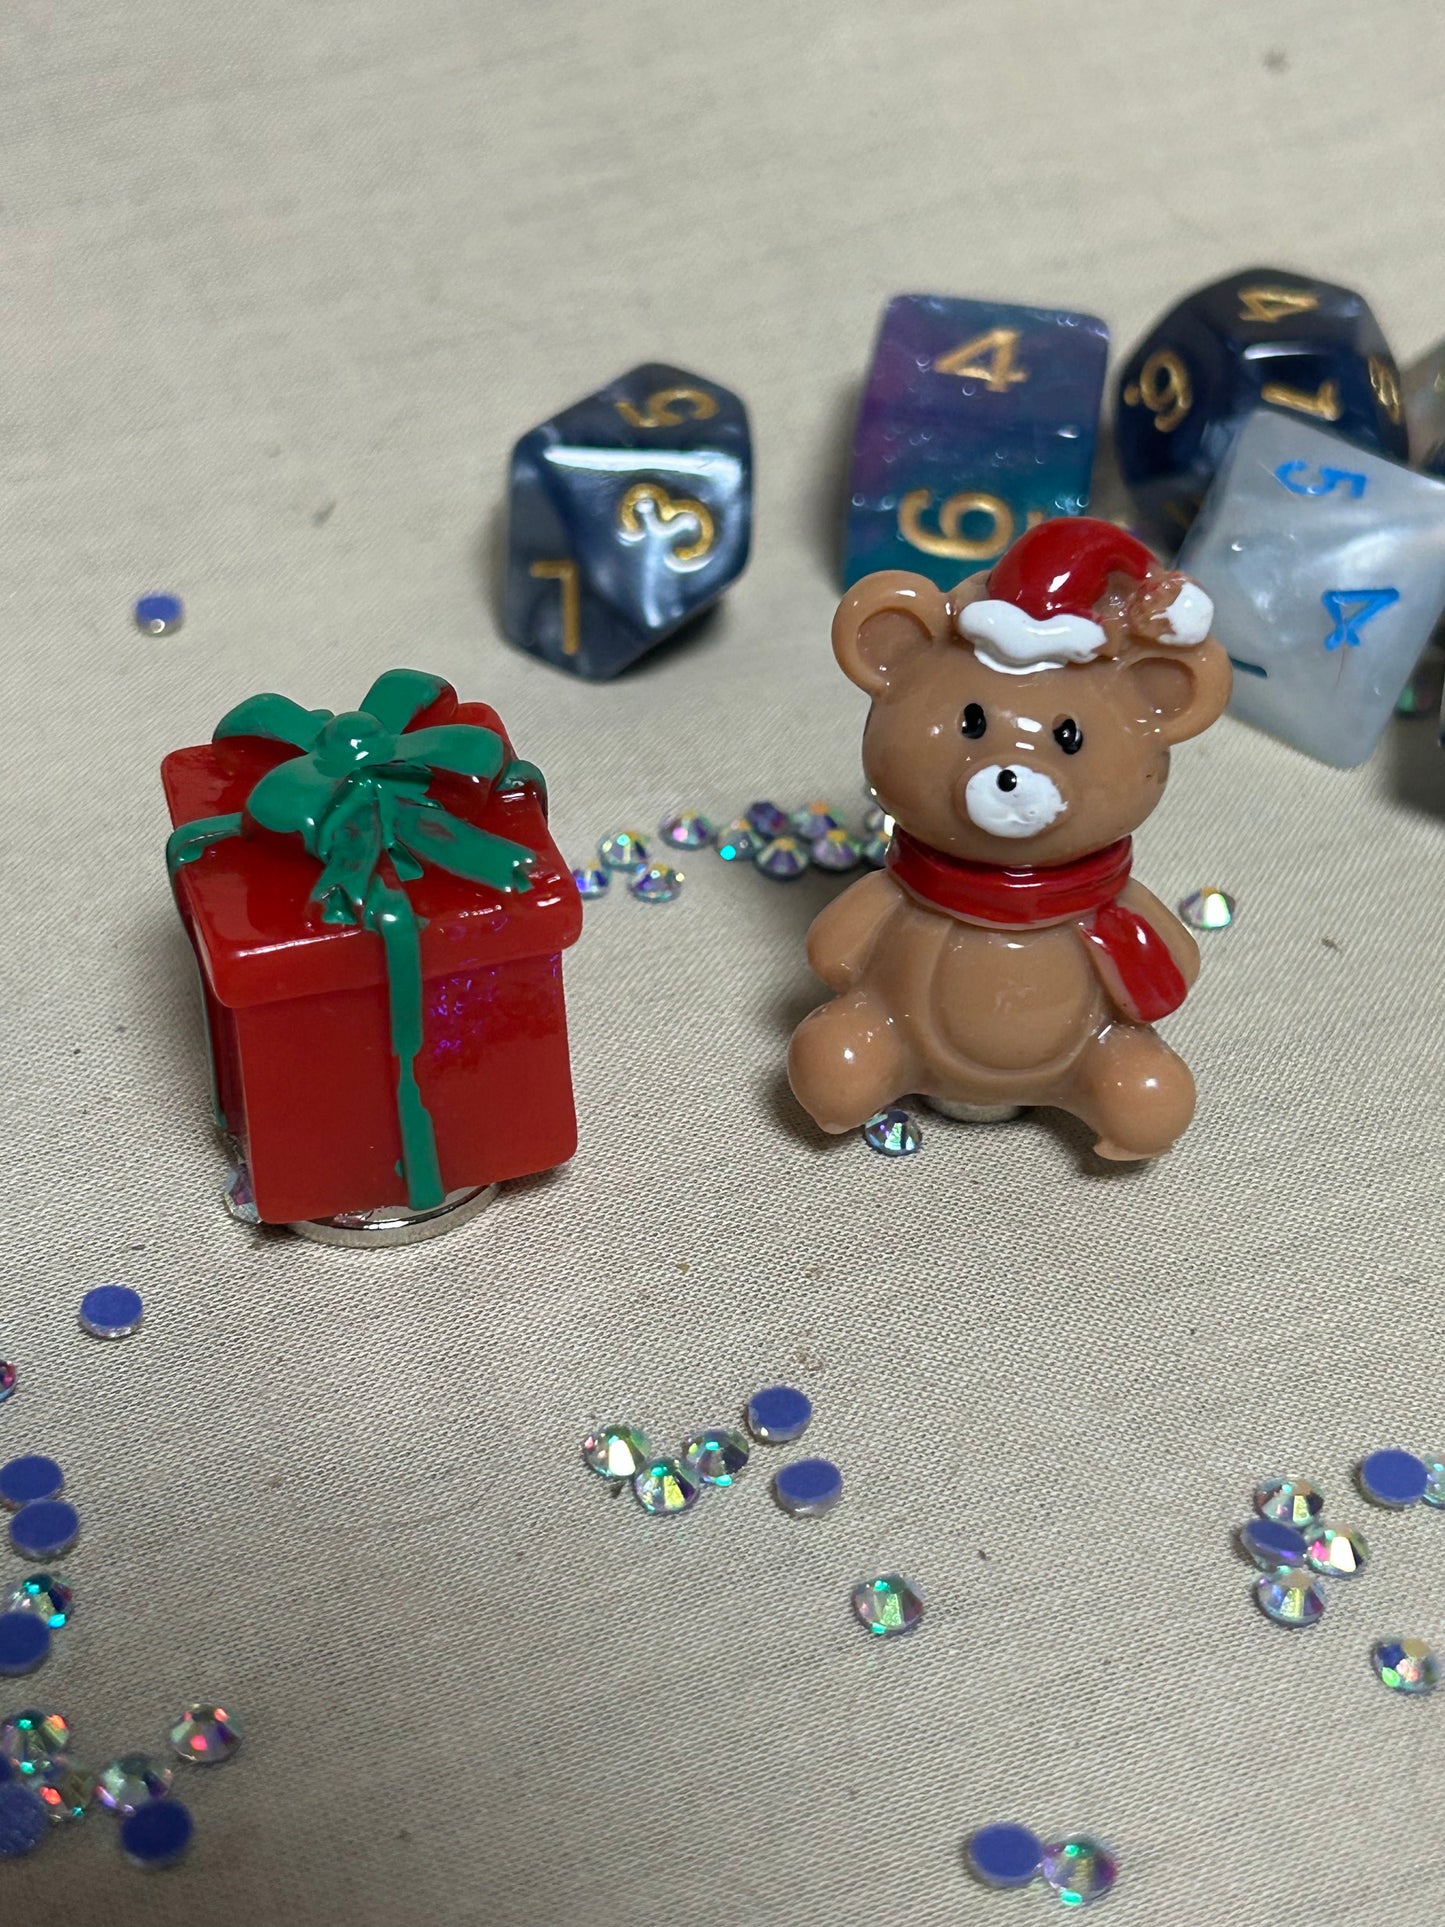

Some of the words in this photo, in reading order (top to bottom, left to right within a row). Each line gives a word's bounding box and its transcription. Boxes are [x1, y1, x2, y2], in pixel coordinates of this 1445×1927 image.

[934, 328, 1031, 393] 4
[613, 387, 720, 428] 5
[1274, 460, 1368, 499] 5
[618, 482, 715, 568] 3
[1321, 587, 1400, 651] 4
